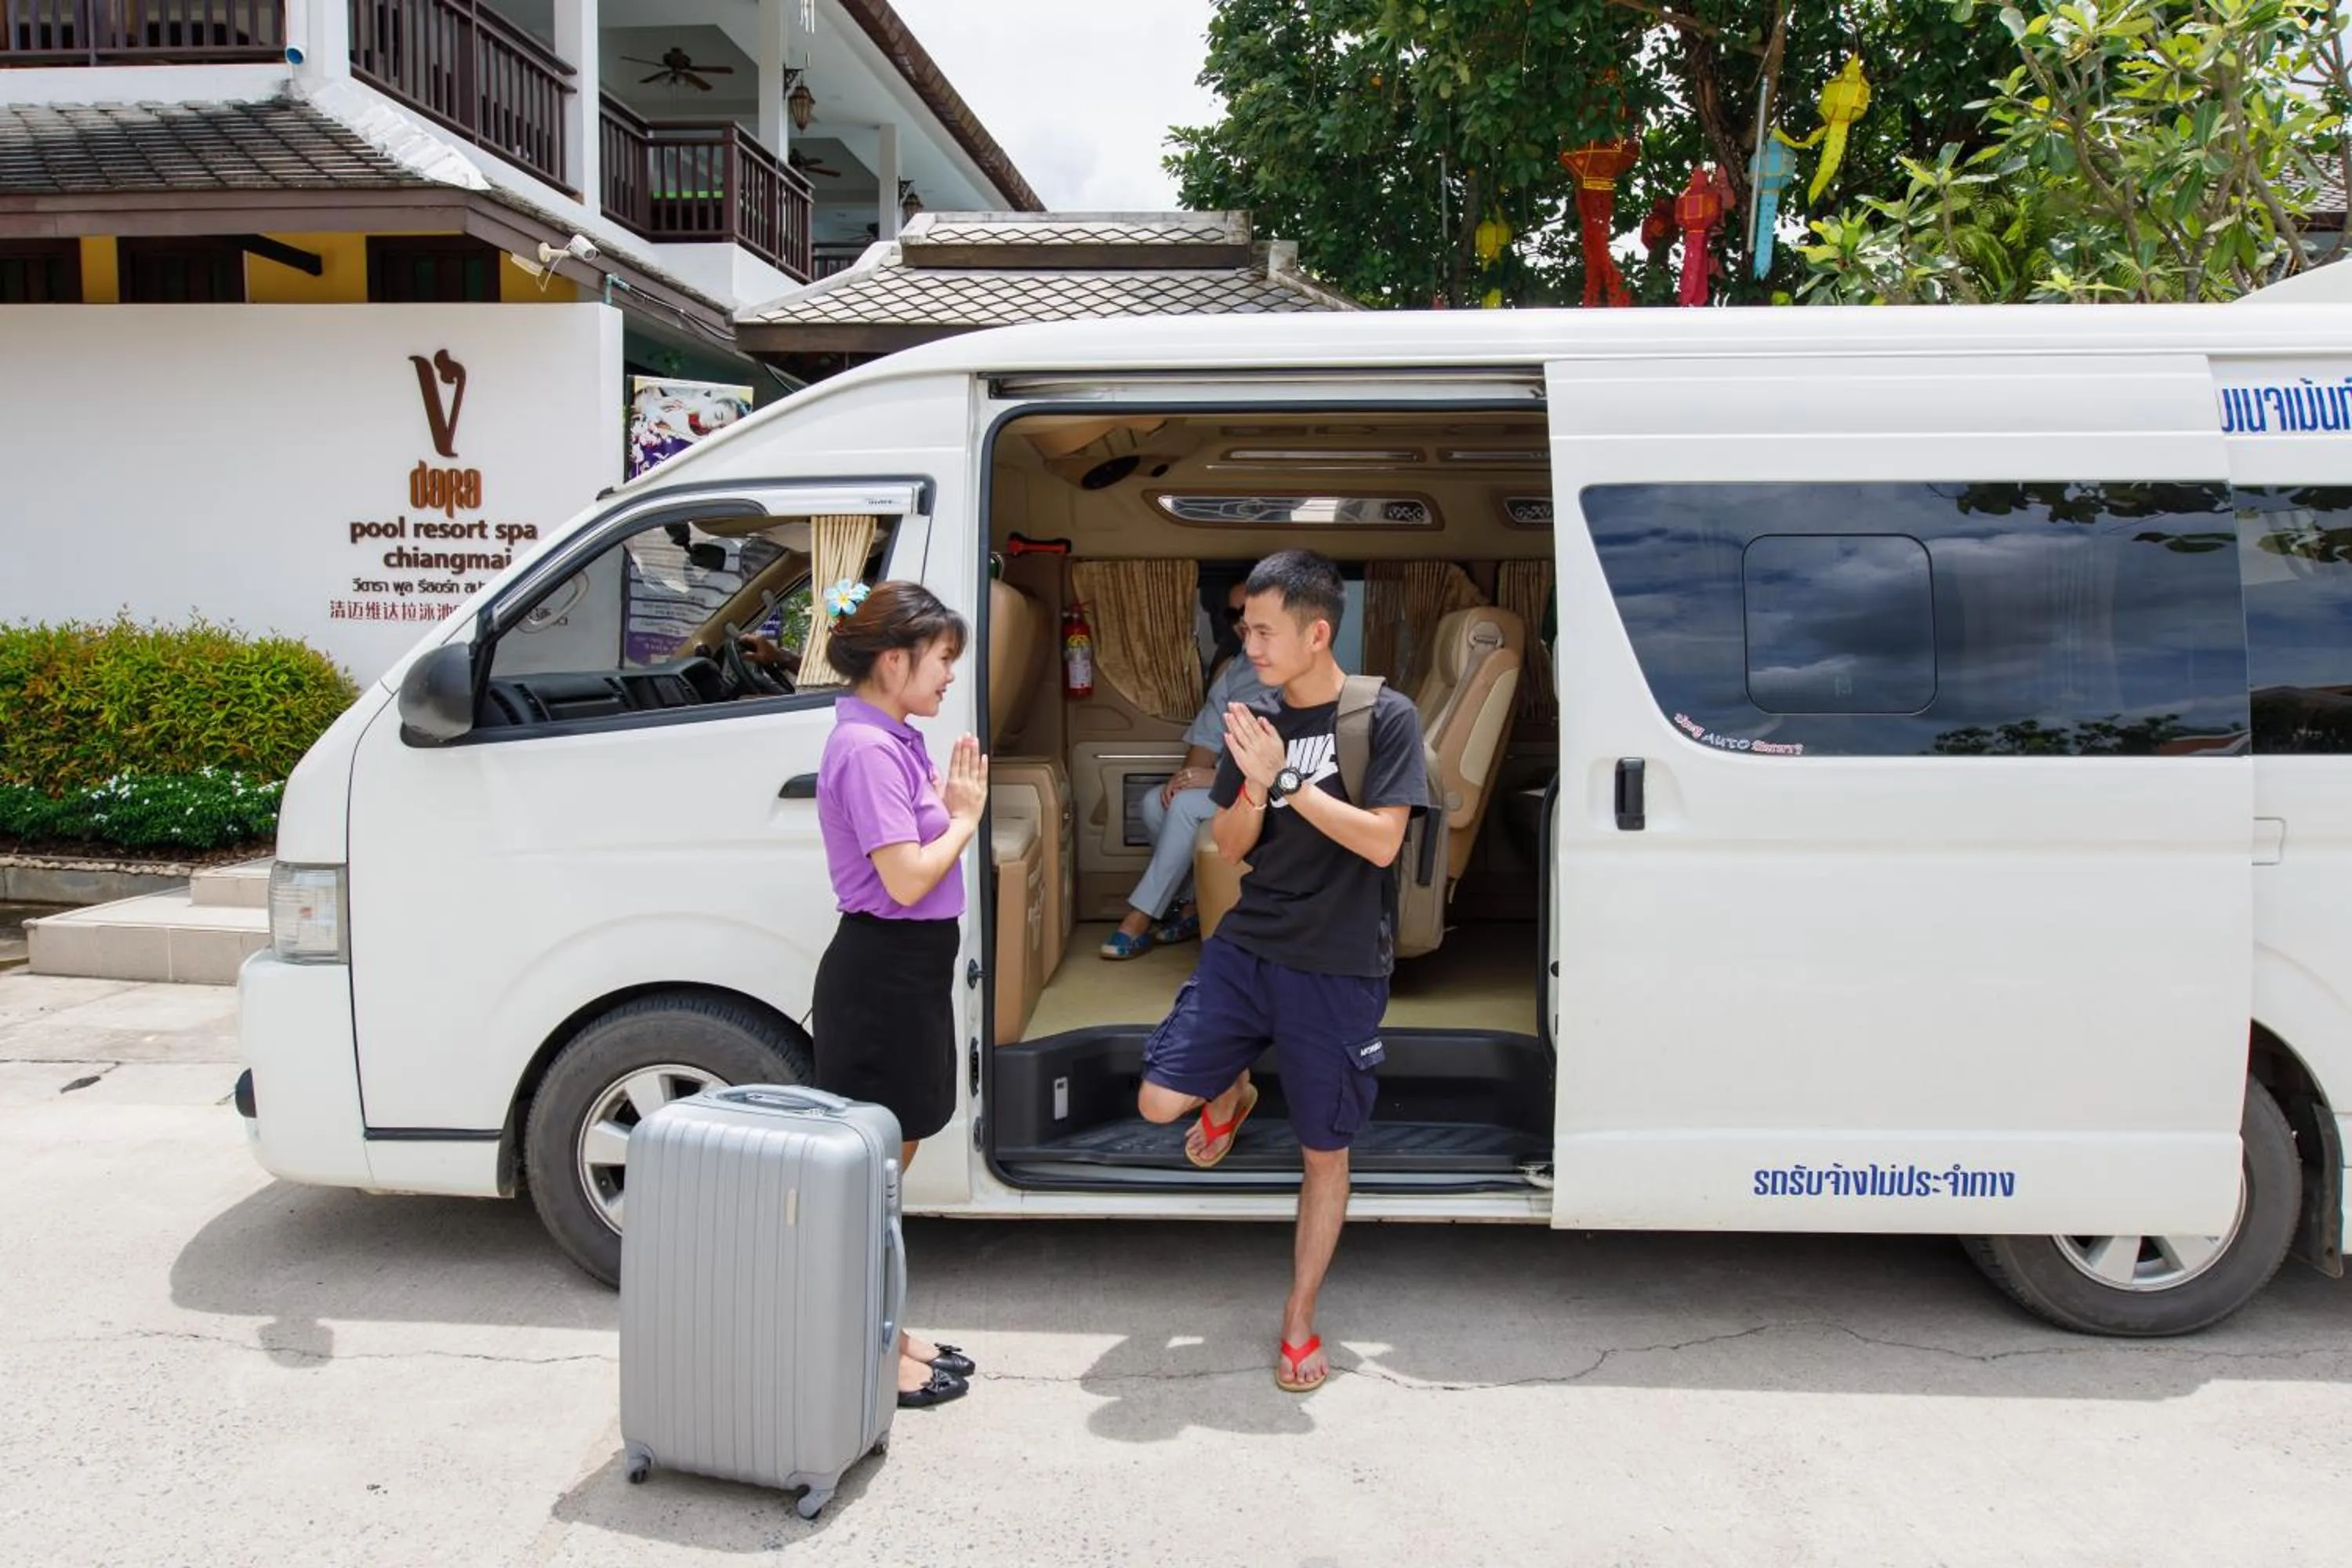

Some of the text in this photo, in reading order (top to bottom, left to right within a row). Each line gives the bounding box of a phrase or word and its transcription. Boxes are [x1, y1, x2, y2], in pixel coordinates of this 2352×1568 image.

[350, 516, 538, 546] pool resort spa
[383, 546, 513, 575] chiangmai
